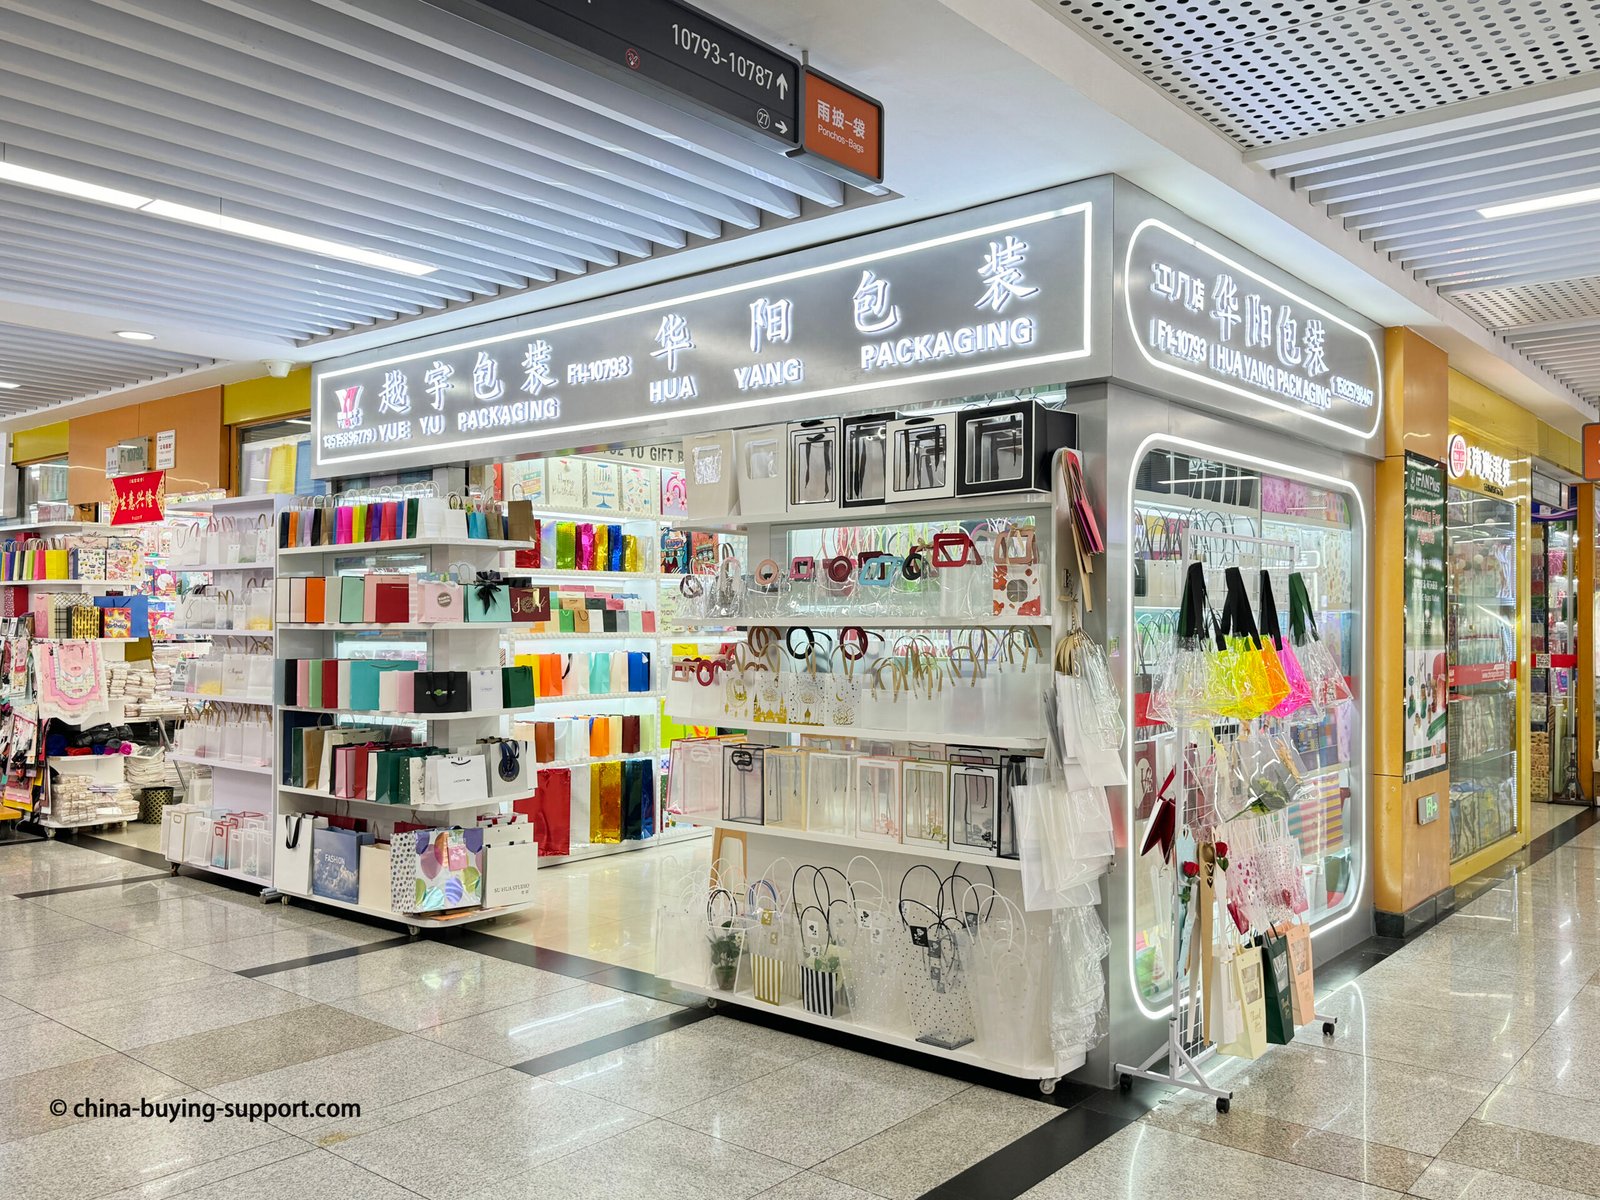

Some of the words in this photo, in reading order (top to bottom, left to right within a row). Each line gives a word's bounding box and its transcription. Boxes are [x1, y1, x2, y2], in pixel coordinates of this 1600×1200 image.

[671, 23, 773, 90] 10793-10787
[757, 109, 770, 127] 27
[817, 124, 865, 154] Ponchos-Bags
[649, 235, 1038, 371] 华阳包装
[1150, 262, 1205, 312] 工厂店
[1210, 273, 1329, 377] 华阳包装
[567, 355, 632, 385] F1-10793
[649, 375, 697, 403] HUA
[733, 357, 804, 389] YANG
[860, 316, 1036, 370] PACKAGING
[1275, 368, 1332, 409] PACKAGING
[378, 420, 411, 442] YUE
[419, 414, 446, 436] YU
[457, 398, 560, 431] PACKAGING
[650, 447, 674, 463] GIFT
